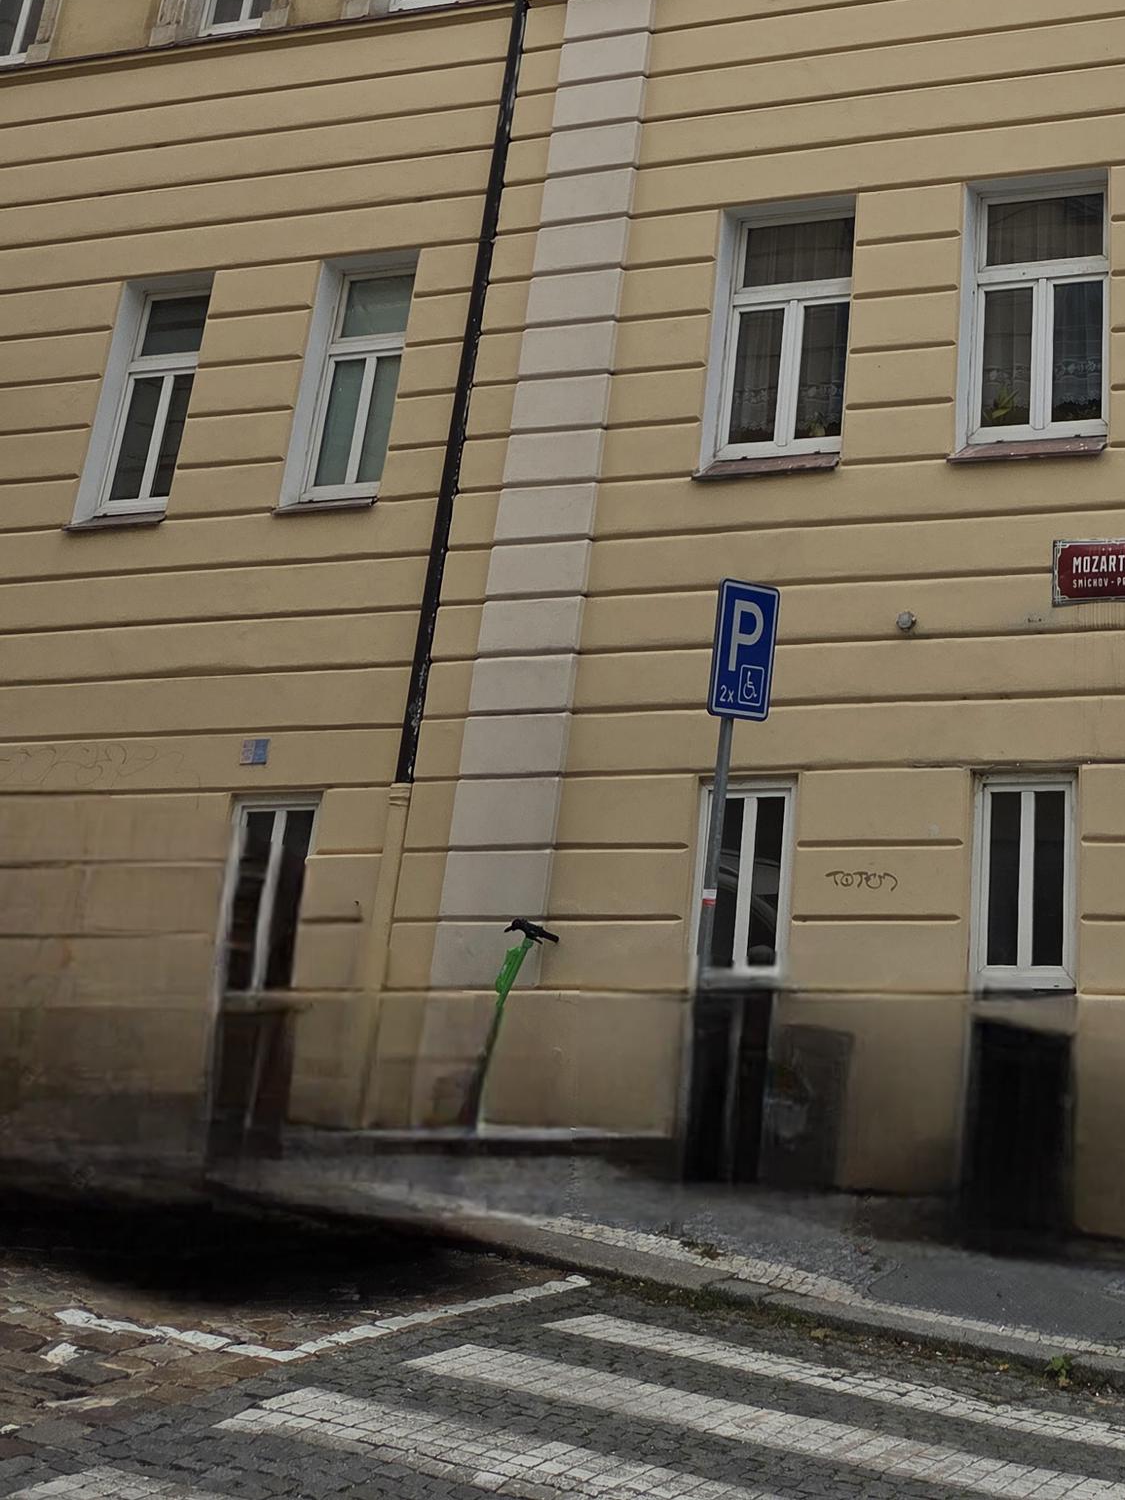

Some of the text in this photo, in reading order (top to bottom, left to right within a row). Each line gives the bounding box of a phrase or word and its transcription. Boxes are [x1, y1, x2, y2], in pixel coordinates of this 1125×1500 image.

[1072, 577, 1109, 589] SMÍCHOV
[728, 599, 764, 672] P
[719, 684, 735, 704] 2x
